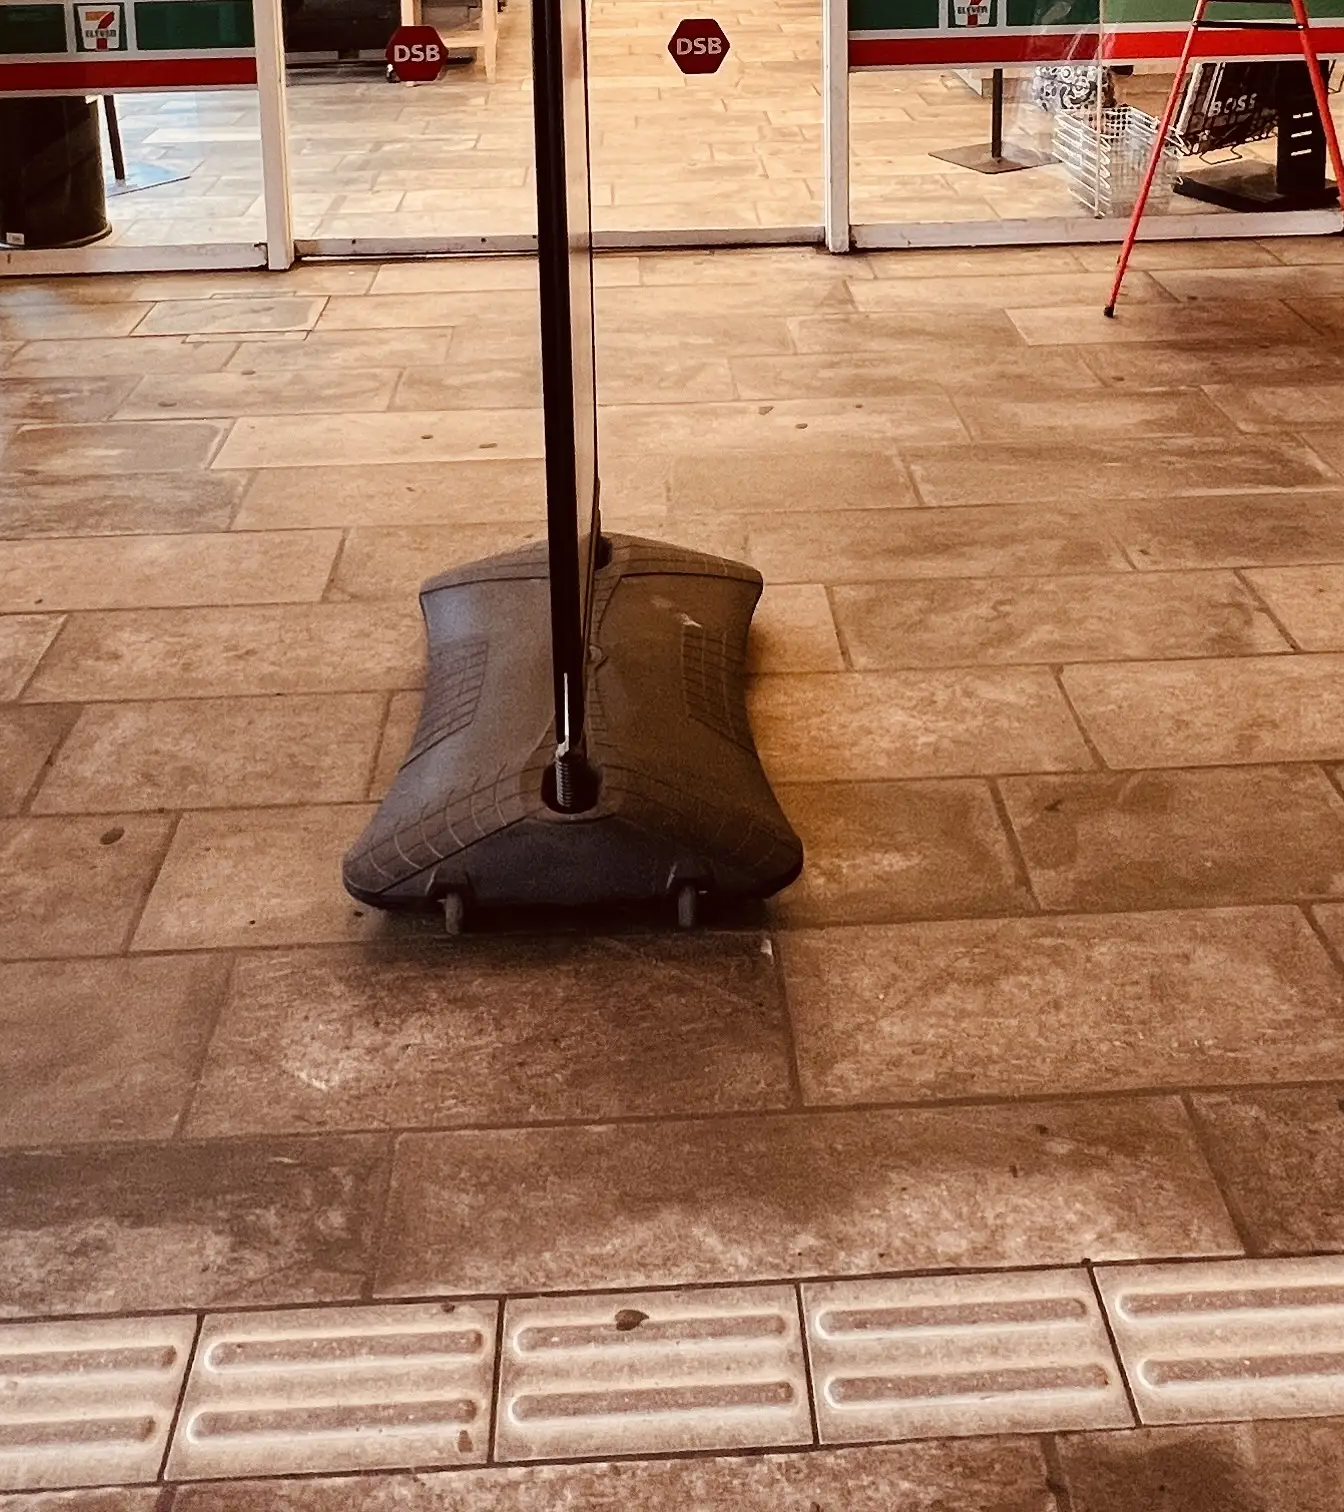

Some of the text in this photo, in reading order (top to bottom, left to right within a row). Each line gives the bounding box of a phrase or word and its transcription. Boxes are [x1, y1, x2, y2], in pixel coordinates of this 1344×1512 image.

[393, 44, 441, 63] DSB
[676, 37, 723, 55] DSB
[1207, 92, 1258, 118] BOSS
